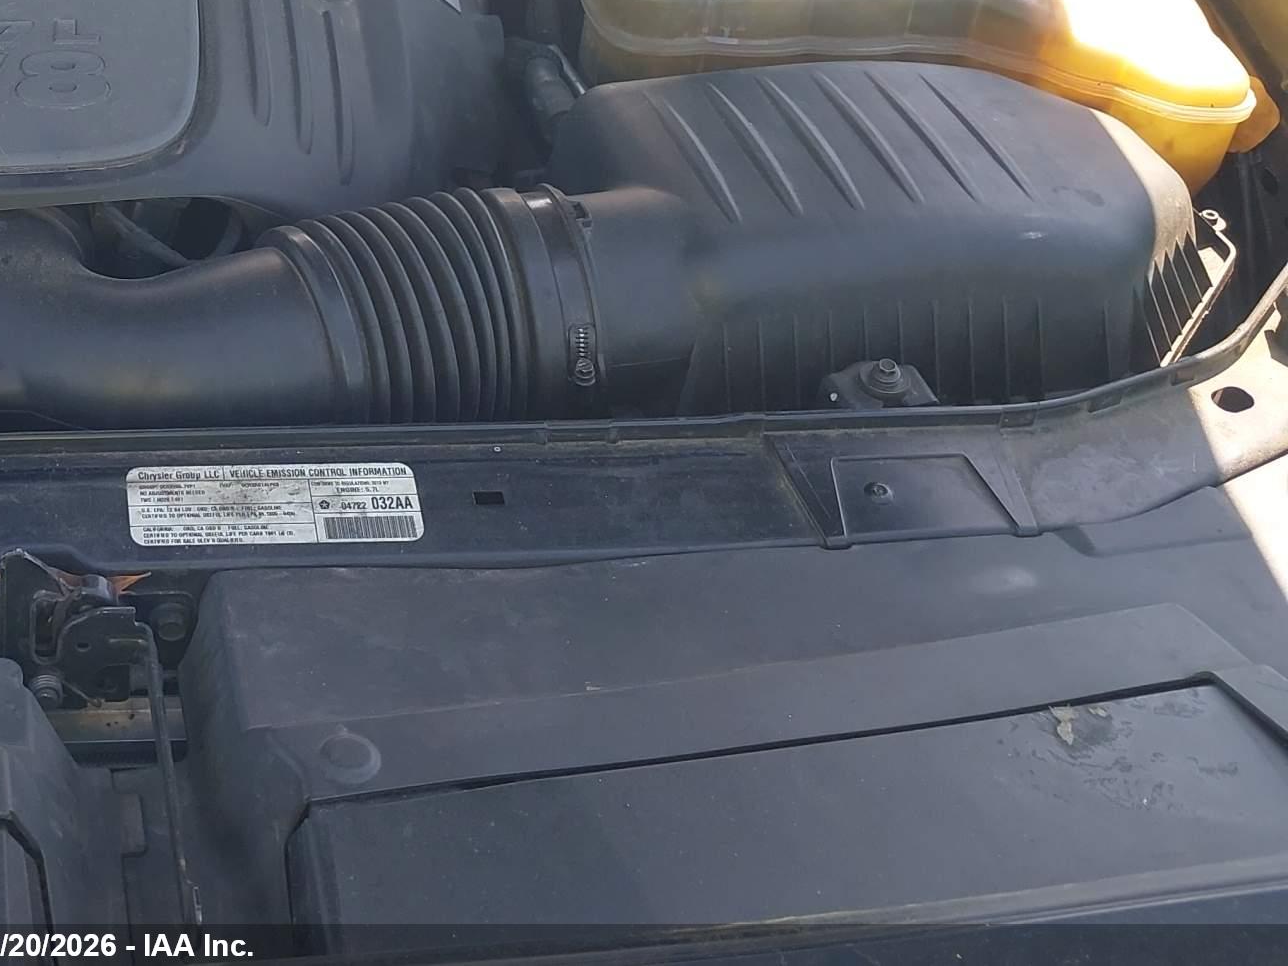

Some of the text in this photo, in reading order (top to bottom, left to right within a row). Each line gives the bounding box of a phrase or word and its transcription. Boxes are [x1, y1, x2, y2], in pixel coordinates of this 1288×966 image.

[138, 470, 220, 481] Chrysler Group LLC
[229, 467, 407, 478] VEHICLE EMISSION CONTROL INFORMATION
[371, 496, 413, 510] 032AA
